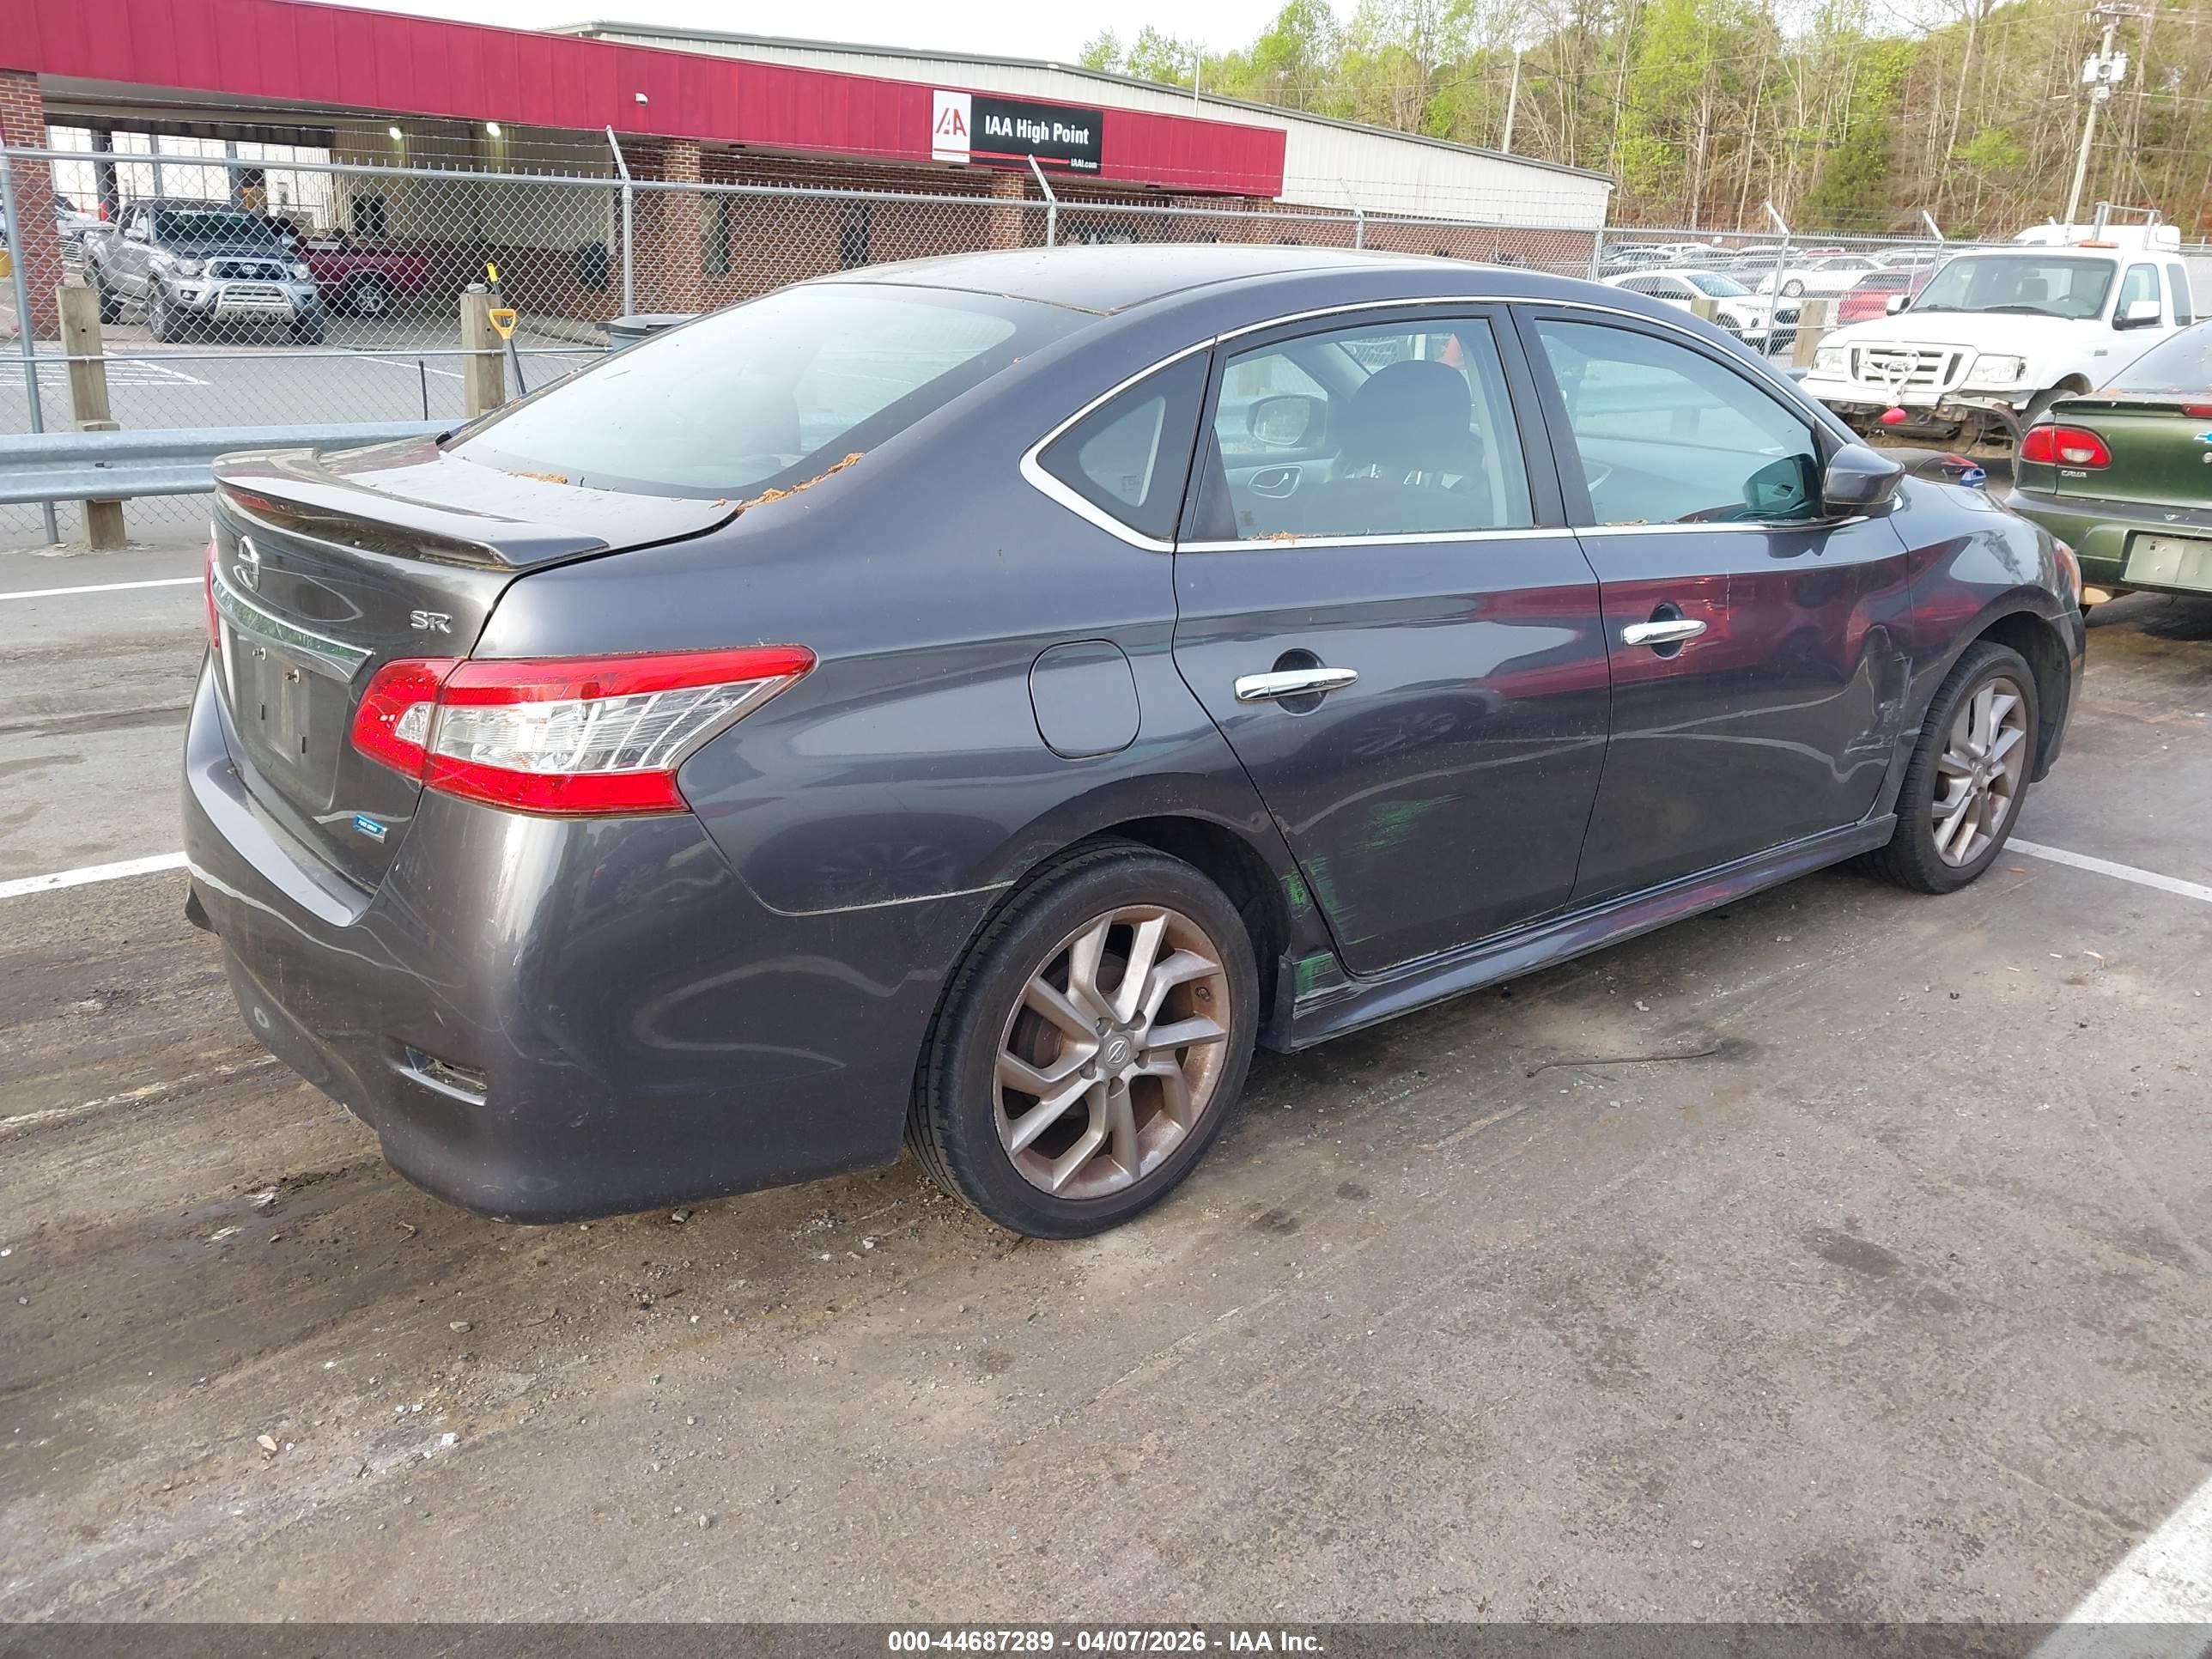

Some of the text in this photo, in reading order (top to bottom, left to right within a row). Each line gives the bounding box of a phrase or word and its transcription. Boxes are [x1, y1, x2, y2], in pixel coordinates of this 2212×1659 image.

[984, 114, 1090, 145] IAA High Point
[410, 610, 453, 634] SR
